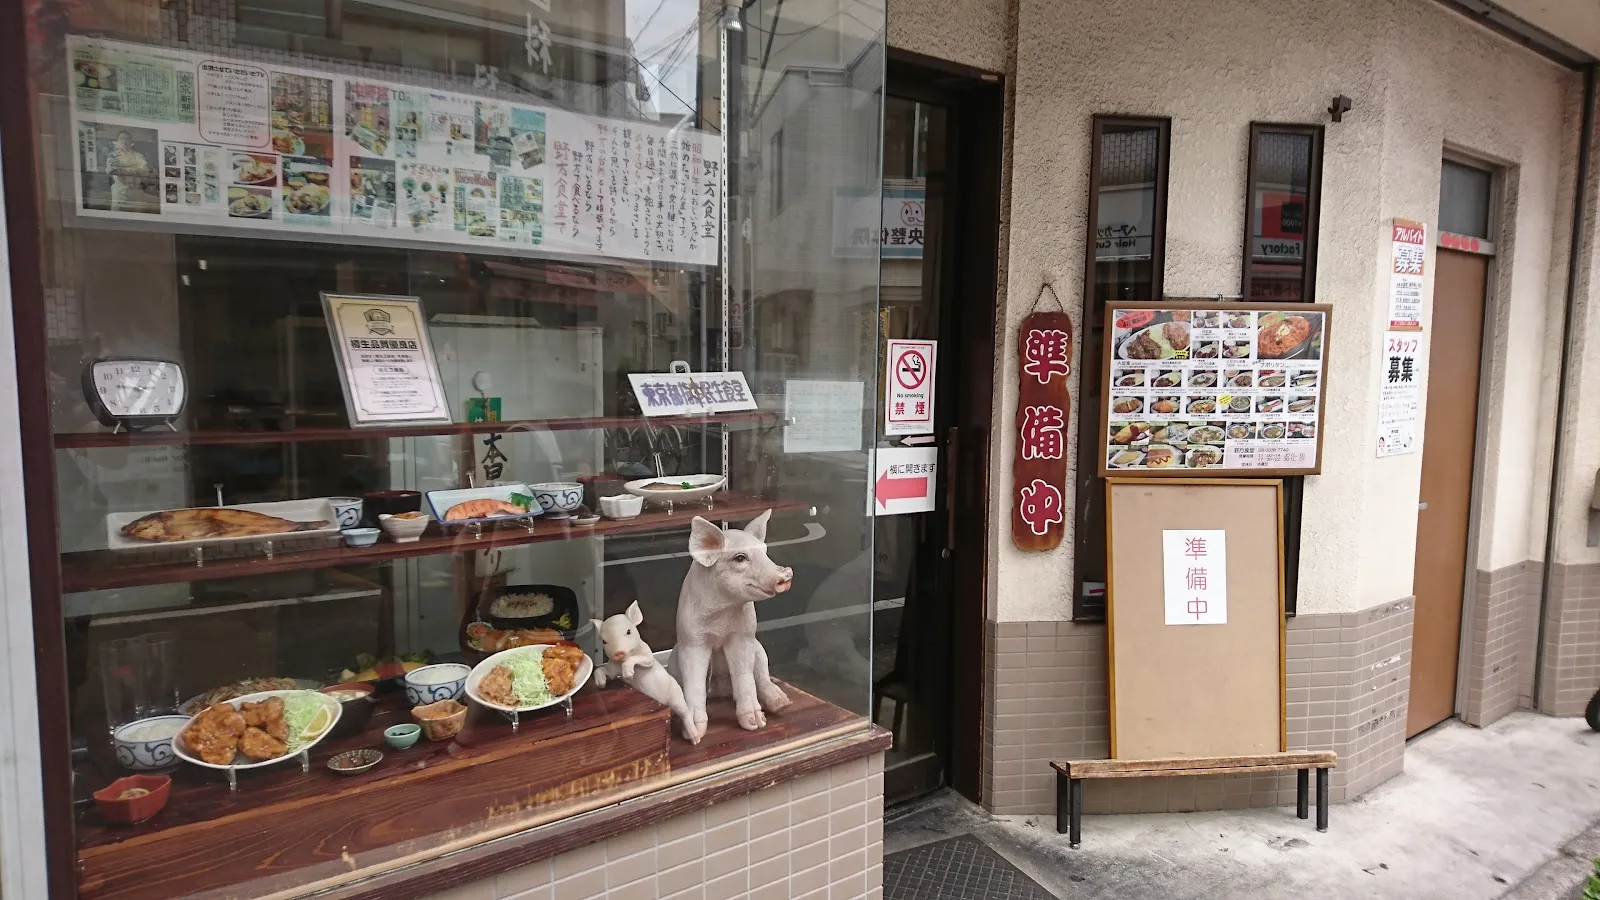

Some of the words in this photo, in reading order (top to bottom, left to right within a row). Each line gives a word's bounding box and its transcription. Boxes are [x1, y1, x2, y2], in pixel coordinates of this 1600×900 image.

[180, 74, 192, 113] 東京新聞
[553, 140, 571, 235] 野方食堂で
[571, 150, 584, 239] 野方で食べるなら
[701, 159, 719, 239] 野方食堂
[1395, 226, 1424, 244] アルバイト
[1395, 245, 1424, 274] 募集
[1388, 338, 1418, 353] スタッフ
[1259, 361, 1286, 369] ナポリタン
[1388, 355, 1414, 383] 募集
[894, 401, 926, 416] 禁煙
[904, 392, 925, 400] smoking
[1020, 329, 1070, 535] 準備中
[889, 462, 936, 475] 横に開きます
[1184, 536, 1209, 621] 準備中
